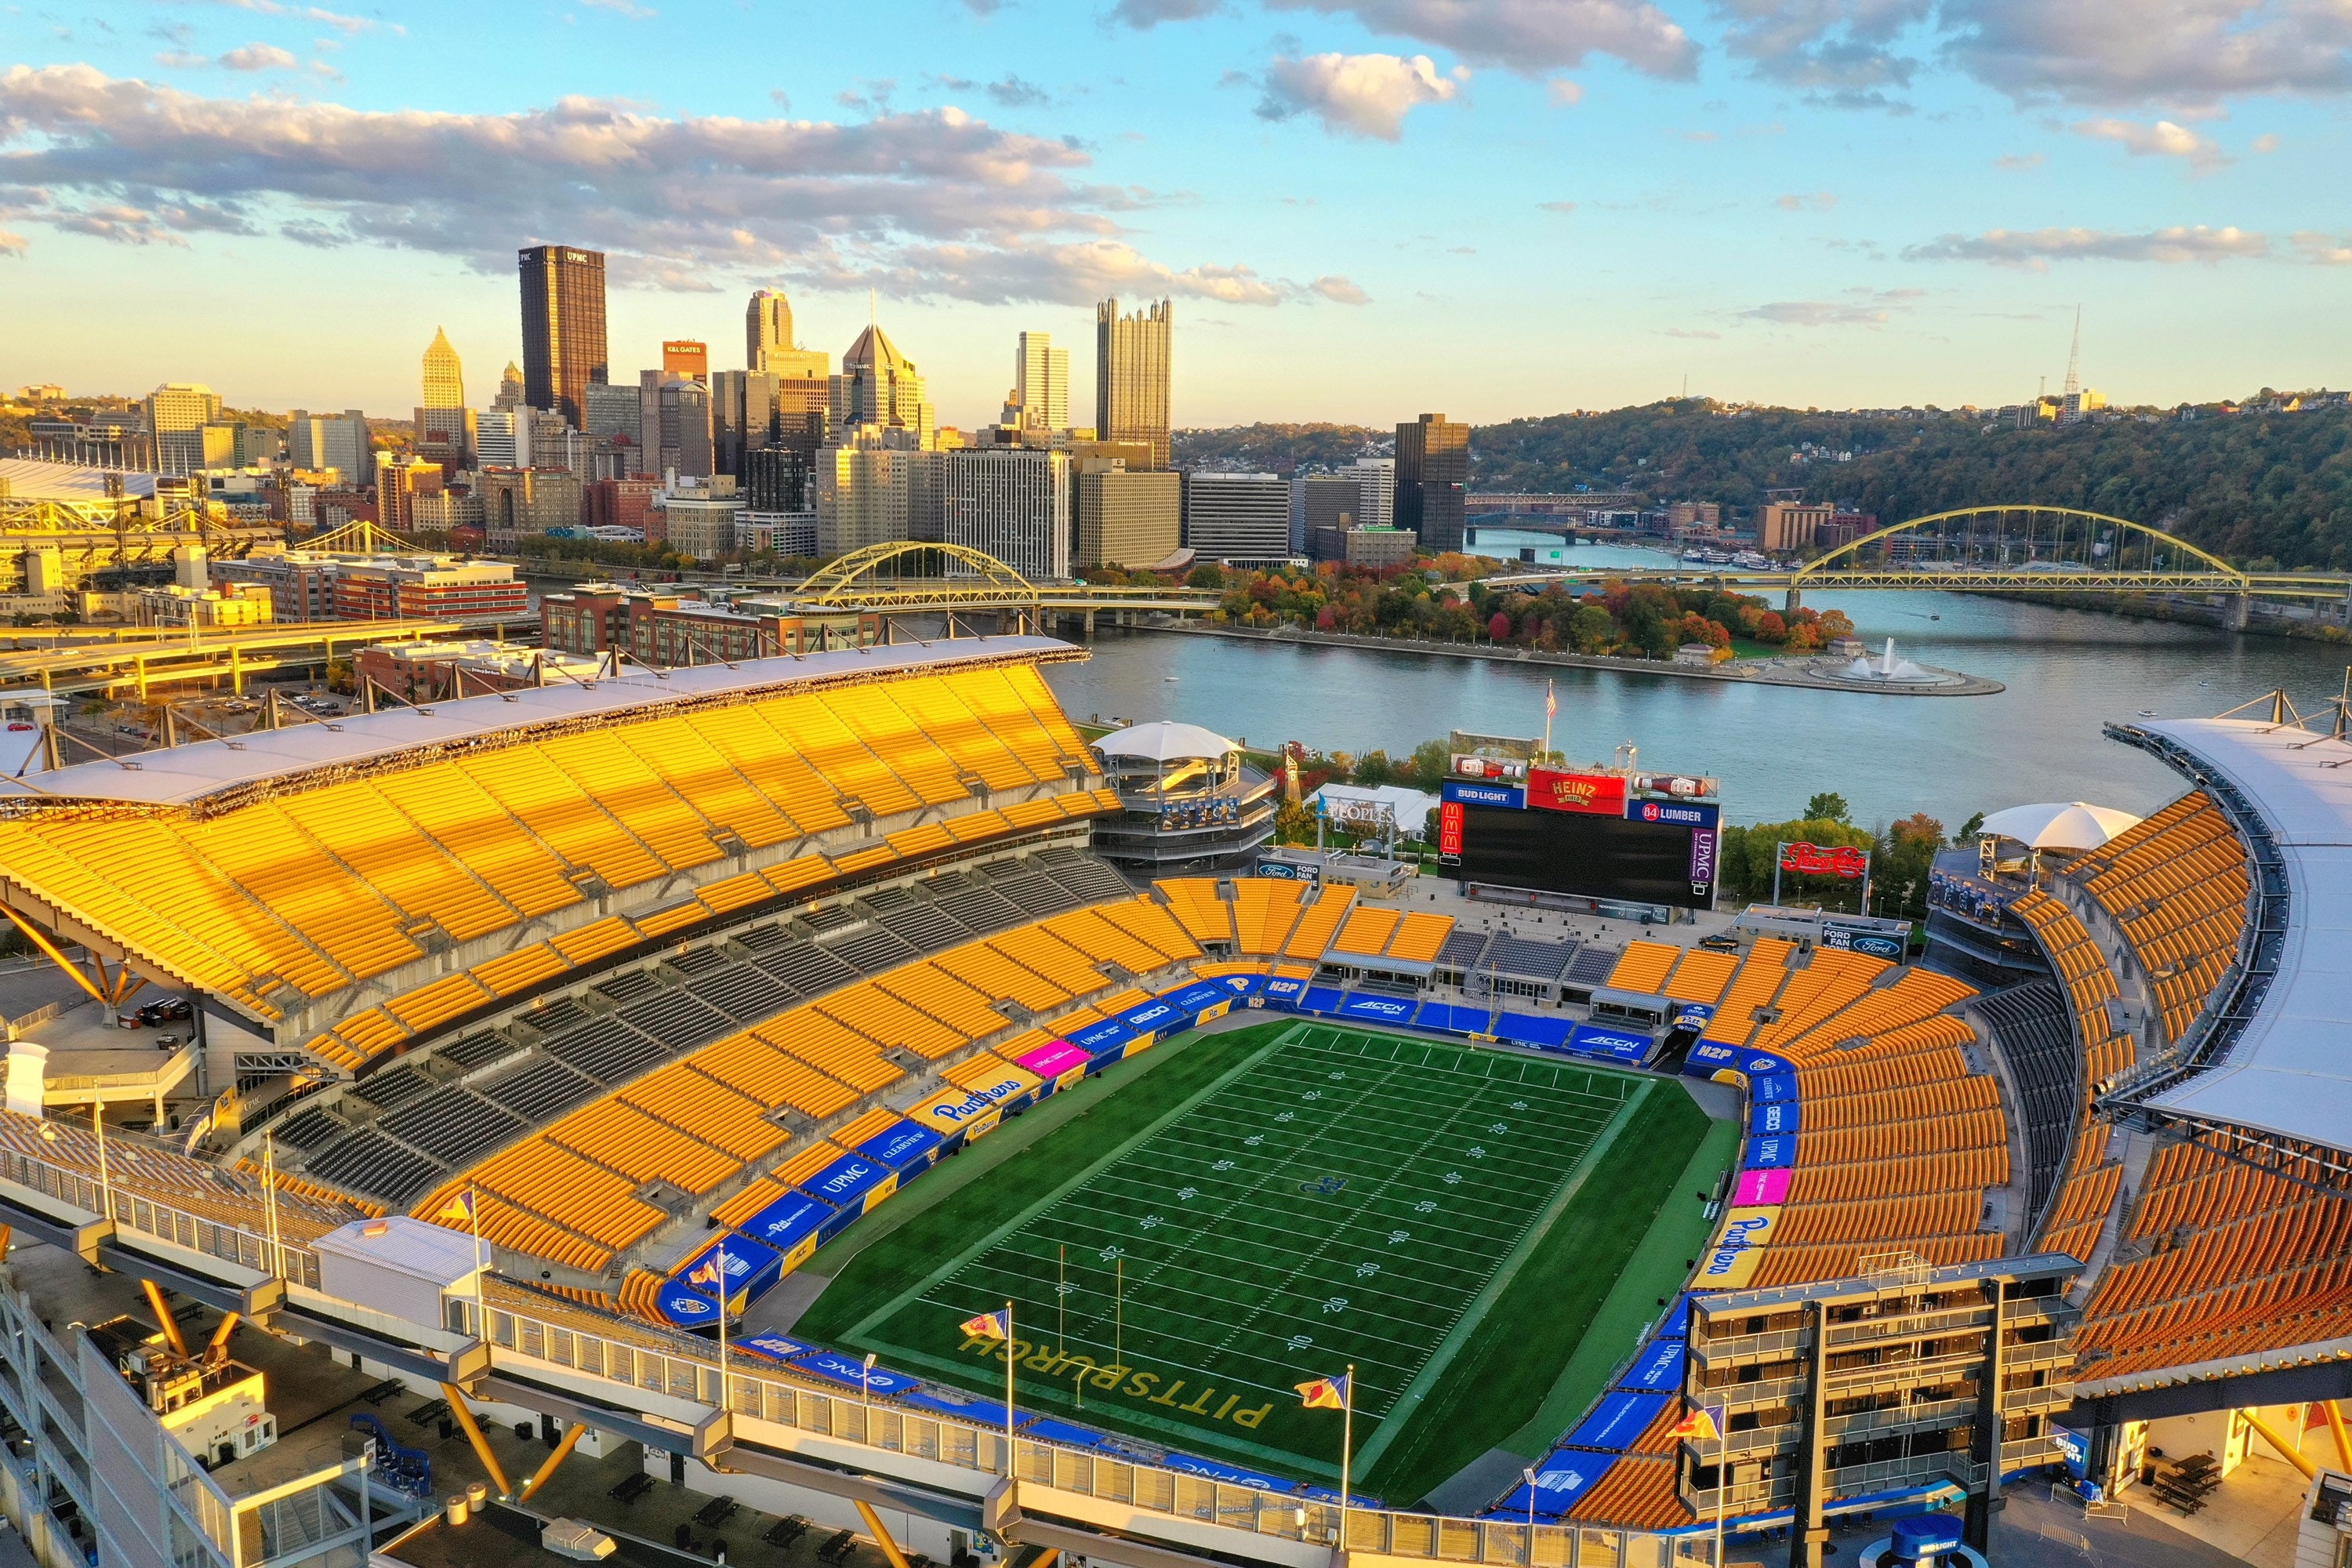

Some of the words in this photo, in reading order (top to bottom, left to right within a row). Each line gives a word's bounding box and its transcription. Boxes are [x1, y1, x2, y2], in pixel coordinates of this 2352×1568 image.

[567, 252, 587, 263] UPMC
[1457, 789, 1479, 798] BUD
[1479, 791, 1508, 802] LIGHT
[1552, 782, 1596, 798] HEINZ
[1566, 795, 1581, 804] FIELD
[1330, 802, 1396, 824] PEOPLES
[1644, 806, 1658, 818] 84
[1660, 808, 1701, 822] LUMBER
[1697, 833, 1711, 878] UPMC
[1265, 867, 1287, 877] Ford
[1824, 930, 1850, 939] FORD
[1830, 938, 1850, 946] FAN
[1862, 941, 1891, 953] Ford
[1268, 981, 1299, 993] H2P
[1180, 990, 1216, 1006] CLEARVIEW
[1248, 996, 1265, 1008] H2P
[1468, 990, 1500, 1004] Allstate
[1350, 1000, 1406, 1011] ACCN
[1129, 1005, 1170, 1024] GEICO
[1080, 1032, 1109, 1045] UPMC
[1580, 1036, 1640, 1048] ACCN
[1697, 1045, 1733, 1060] H2P
[243, 1095, 263, 1112] UPMC
[932, 1080, 1022, 1122] Panthers
[1766, 1105, 1780, 1131] GEICO
[973, 1119, 995, 1135] Panthers
[883, 1131, 926, 1159] CLEARVIEW
[1759, 1139, 1779, 1163] UPMC
[1211, 1160, 1235, 1171] 50
[822, 1163, 869, 1193] UPMC
[1414, 1200, 1438, 1213] 50
[1139, 1214, 1164, 1228] 30
[1099, 1245, 1125, 1260] 20
[1706, 1217, 1769, 1275] Panthers
[1356, 1262, 1381, 1276] 30
[1323, 1297, 1348, 1312] 20
[750, 1338, 803, 1355] H2P
[1653, 1345, 1682, 1369] UPMC
[817, 1359, 869, 1380] PNC
[957, 1332, 1275, 1429] PITTSBURGH
[365, 1442, 376, 1452] Lite
[2056, 1436, 2079, 1454] BUD
[1920, 1544, 1936, 1553] BUD
[1936, 1541, 1958, 1551] LIGHT
